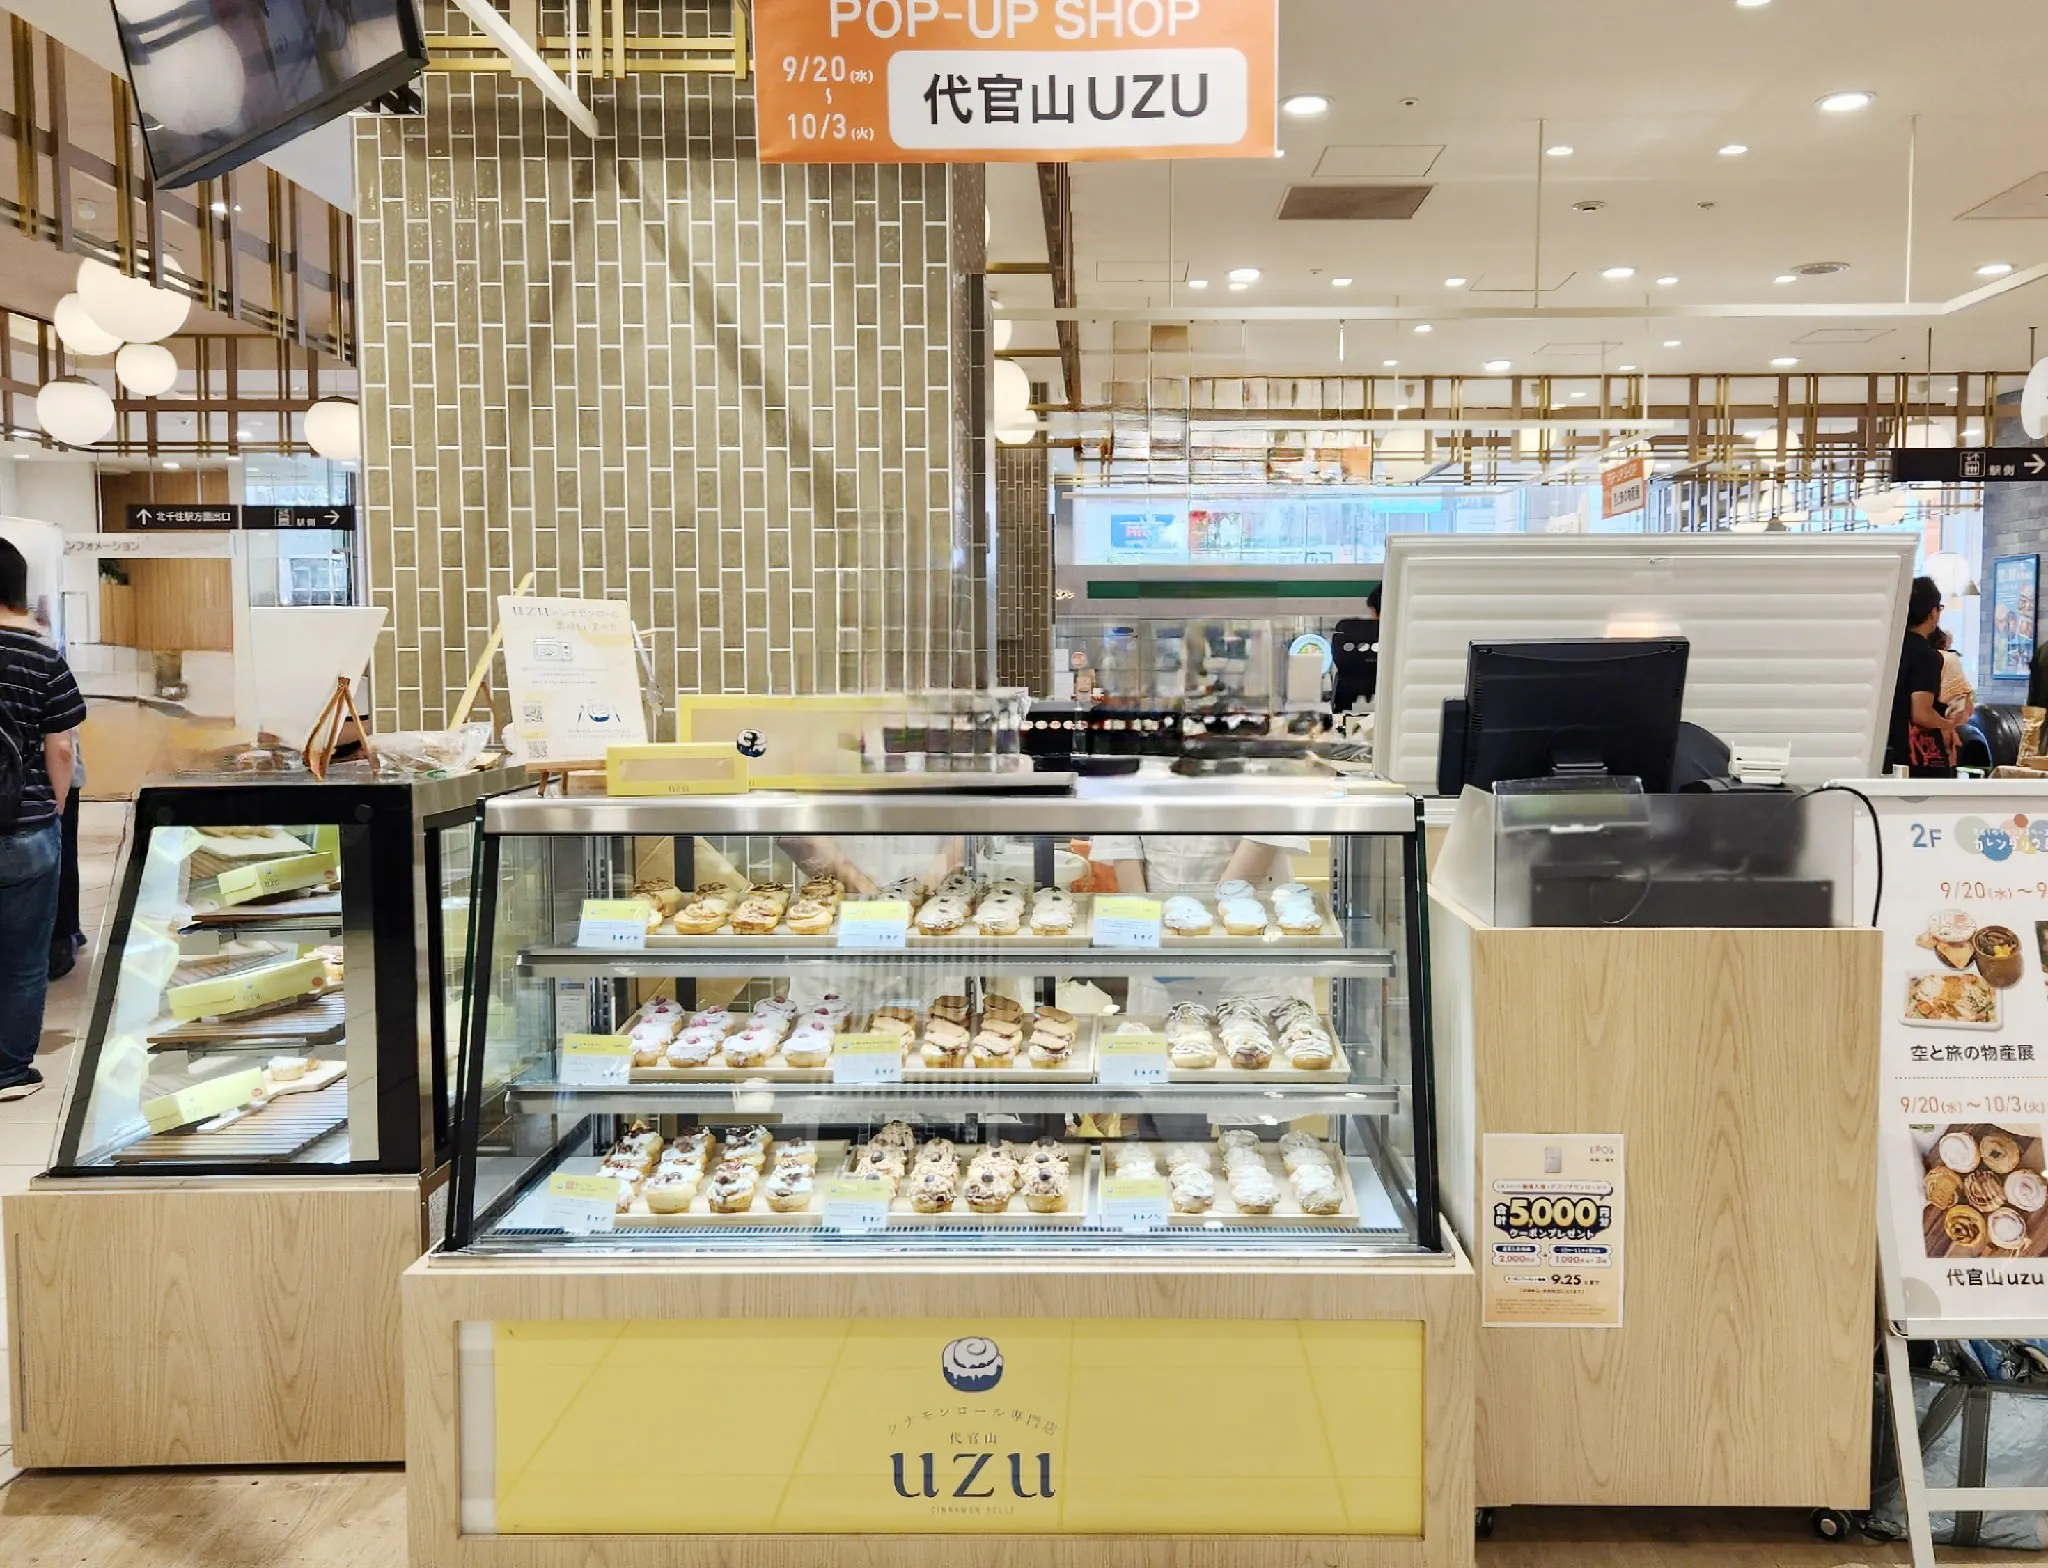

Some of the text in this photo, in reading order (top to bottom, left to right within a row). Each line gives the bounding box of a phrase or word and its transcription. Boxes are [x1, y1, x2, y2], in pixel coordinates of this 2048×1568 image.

[829, 0, 1200, 40] POP-UP SHOP
[1909, 823, 1942, 849] 2F
[1910, 1044, 2036, 1062] 空と旅の物産展
[1509, 1197, 1598, 1229] 5,000
[889, 1452, 1057, 1499] uzu
